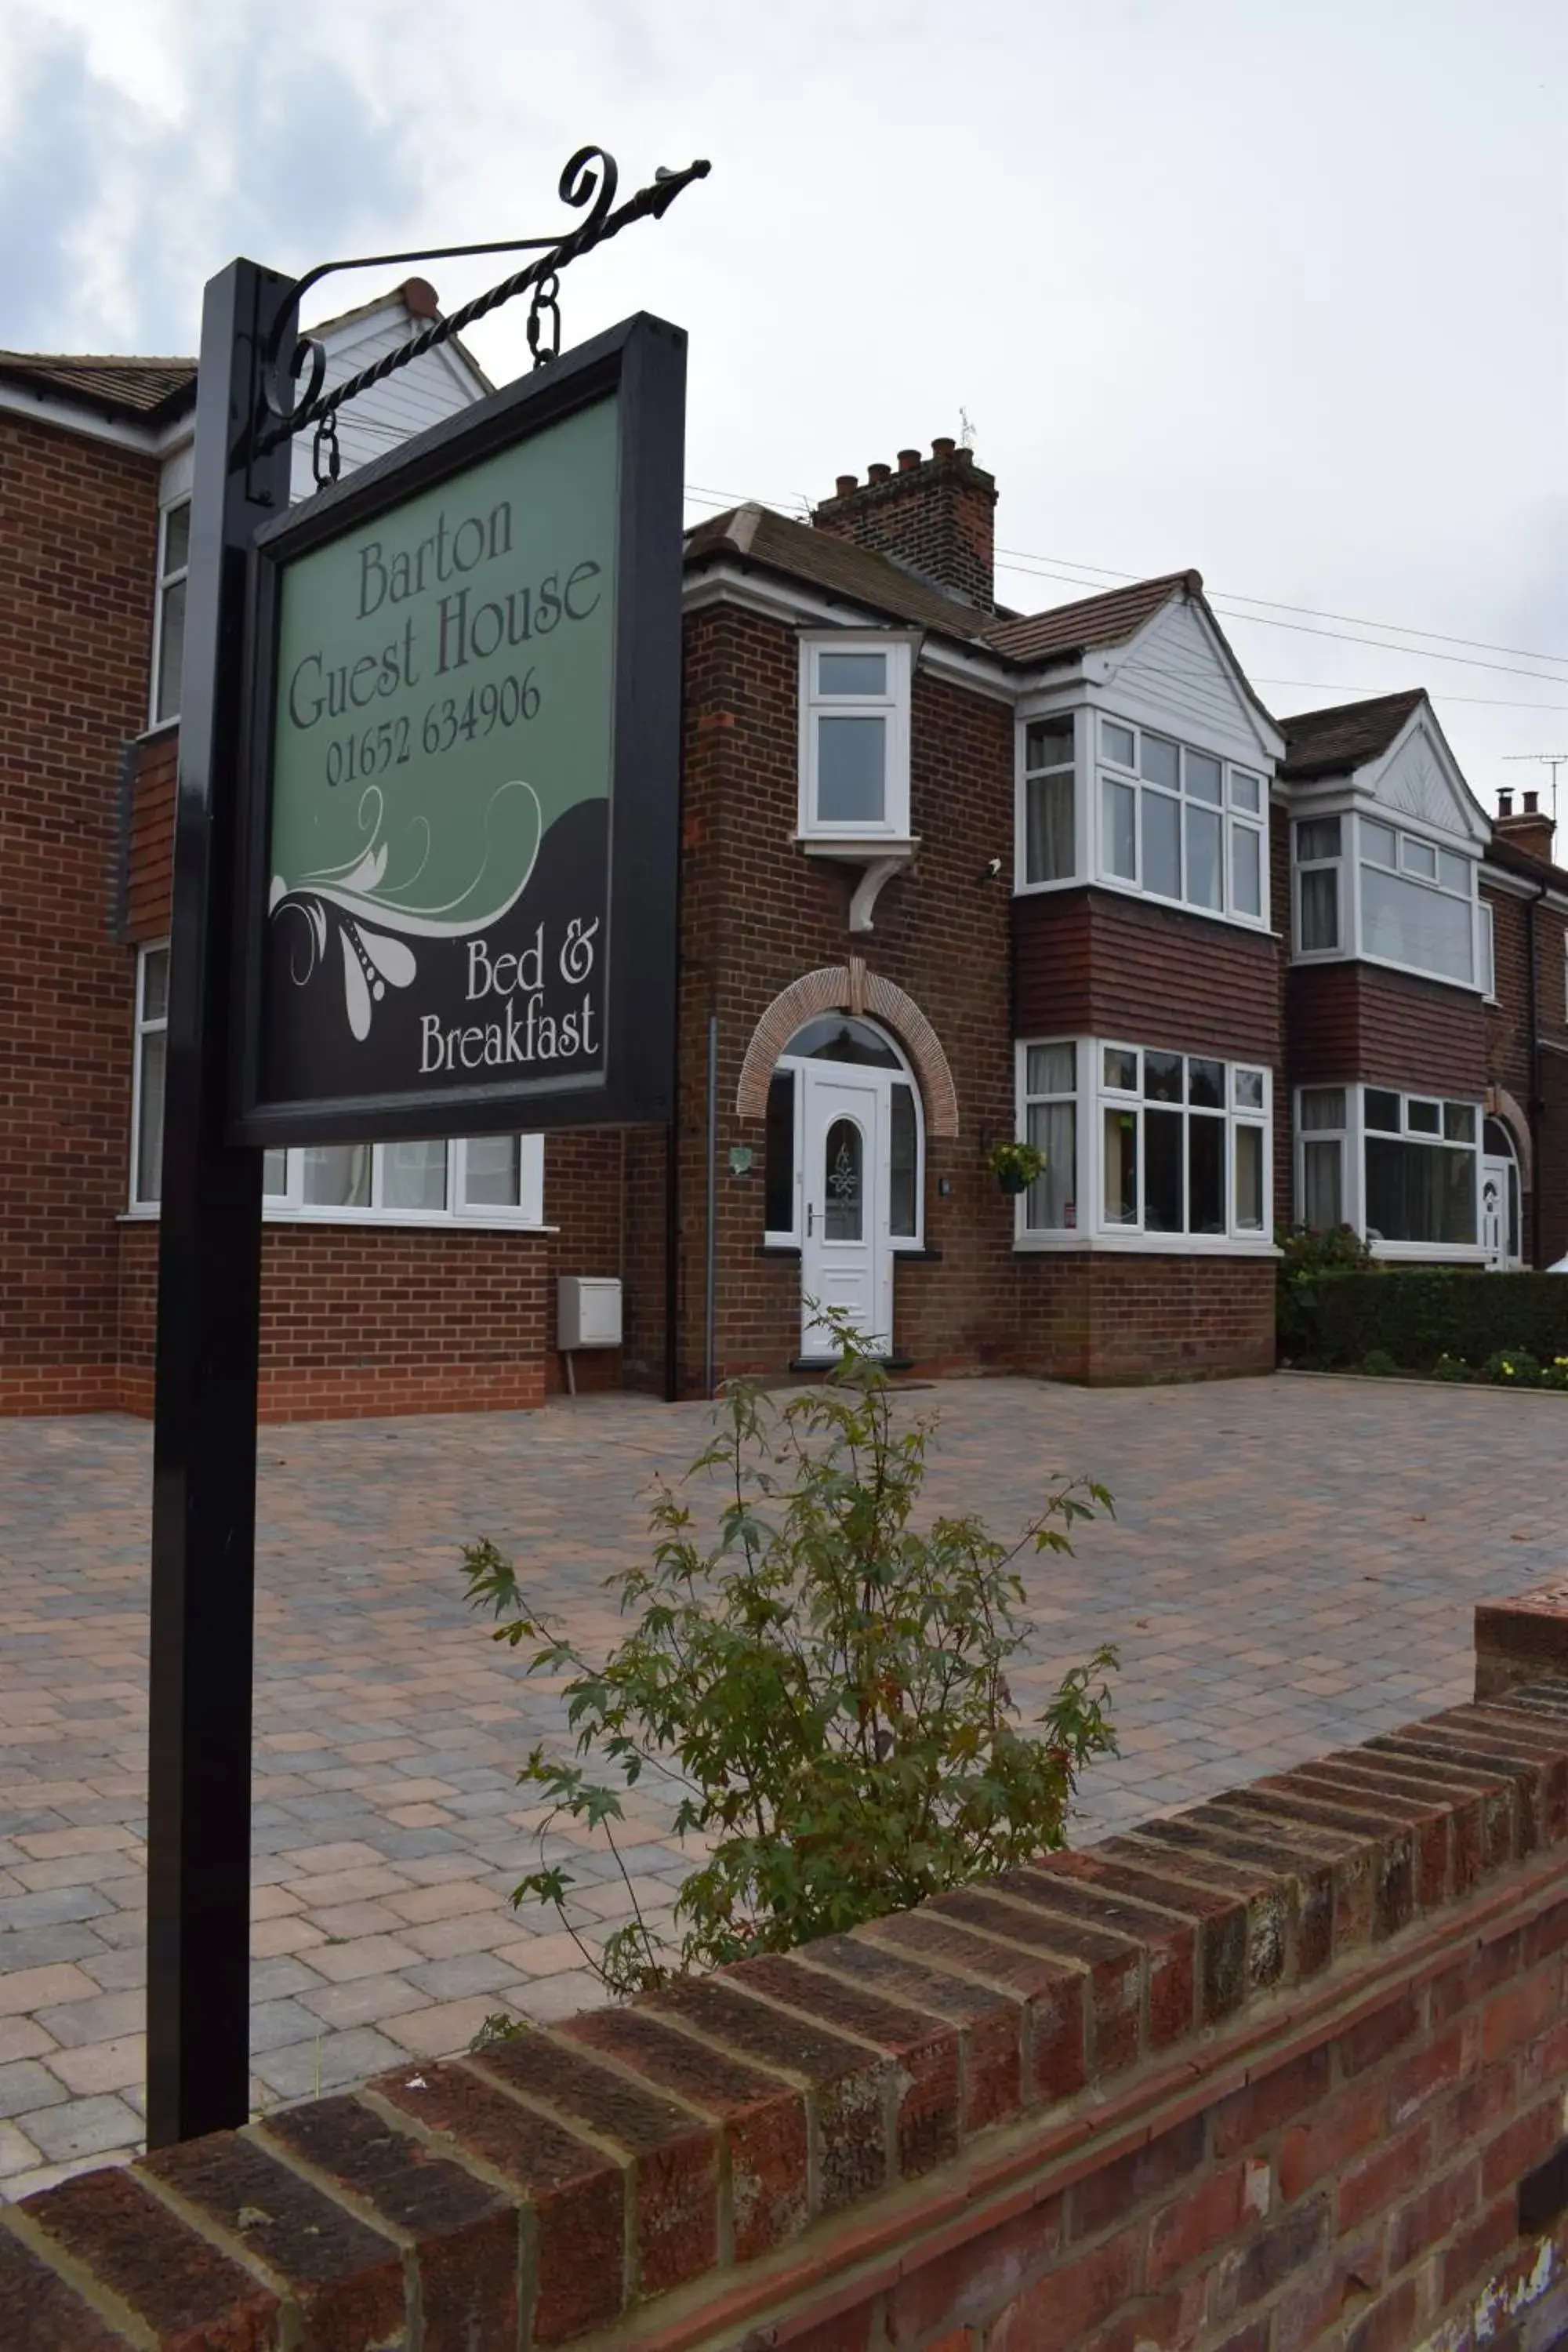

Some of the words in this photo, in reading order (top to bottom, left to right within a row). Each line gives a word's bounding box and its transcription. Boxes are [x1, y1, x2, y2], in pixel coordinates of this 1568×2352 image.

[355, 500, 514, 621] Barton
[289, 615, 420, 730] Guest
[434, 560, 602, 677] House
[325, 716, 411, 786] 01652
[422, 666, 541, 755] 634906
[465, 920, 545, 1000] Bed
[559, 915, 600, 985] &
[418, 992, 599, 1073] Breakfast
